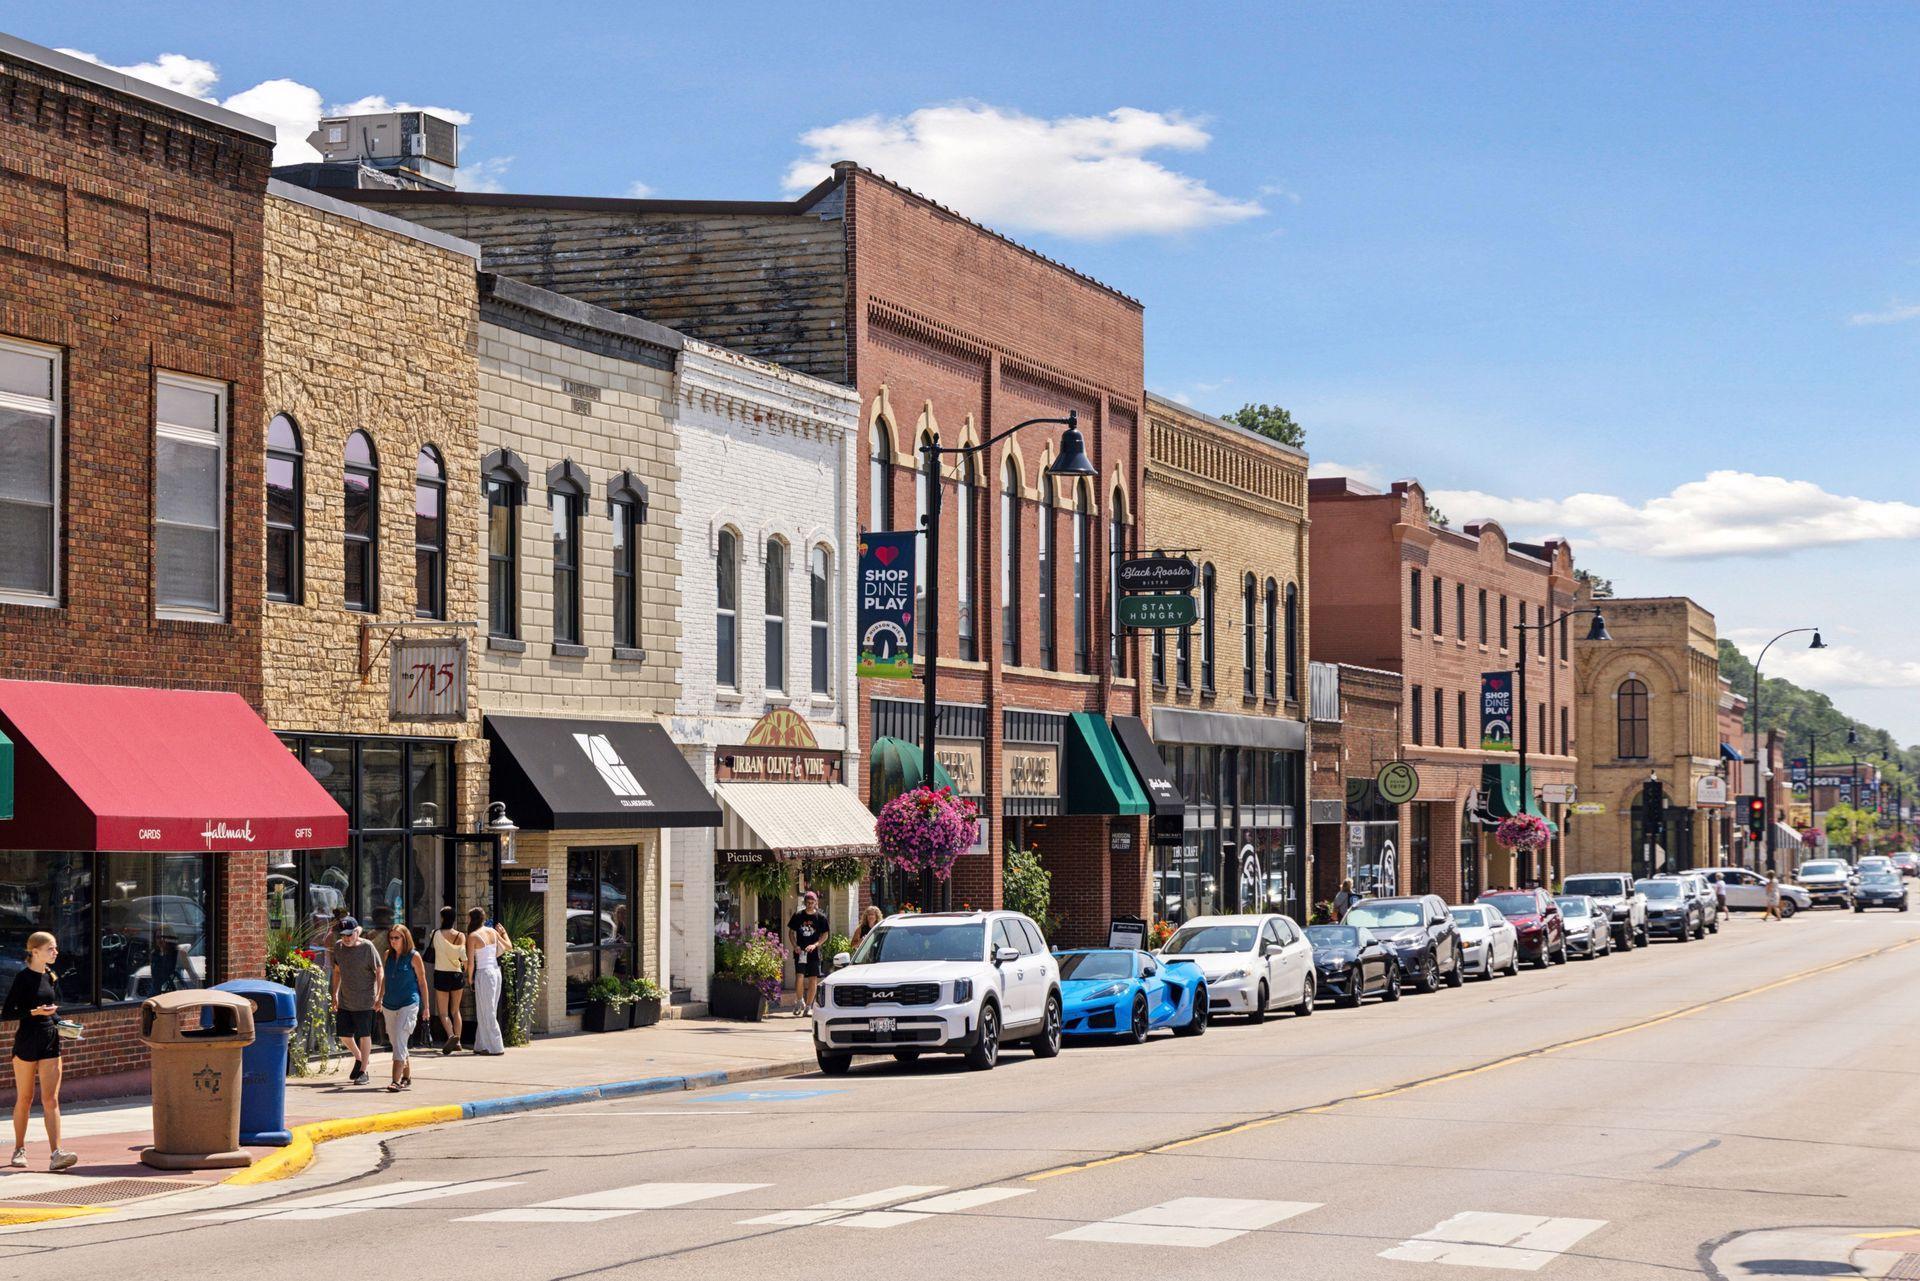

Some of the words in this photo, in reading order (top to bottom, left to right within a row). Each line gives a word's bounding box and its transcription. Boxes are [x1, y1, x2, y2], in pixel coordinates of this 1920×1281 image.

[865, 570, 909, 582] SHOP
[1121, 567, 1151, 579] Black
[1152, 566, 1191, 578] Rooster
[864, 582, 908, 597] DINE
[864, 597, 907, 610] PLAY
[1142, 603, 1173, 611] STAY
[1130, 612, 1183, 620] HUNGRY
[869, 623, 890, 635] HUDSON
[402, 672, 415, 680] the
[408, 662, 454, 699] 715
[1485, 699, 1509, 707] DINE
[1485, 707, 1509, 715] PLAY
[732, 755, 764, 773] URBAN
[767, 756, 793, 774] OLIVE
[794, 755, 802, 778] &
[804, 757, 825, 775] VINE
[139, 829, 161, 840] CARDS
[200, 819, 256, 850] Hallmark
[295, 828, 313, 838] GIFTS
[727, 852, 763, 863] Picnics
